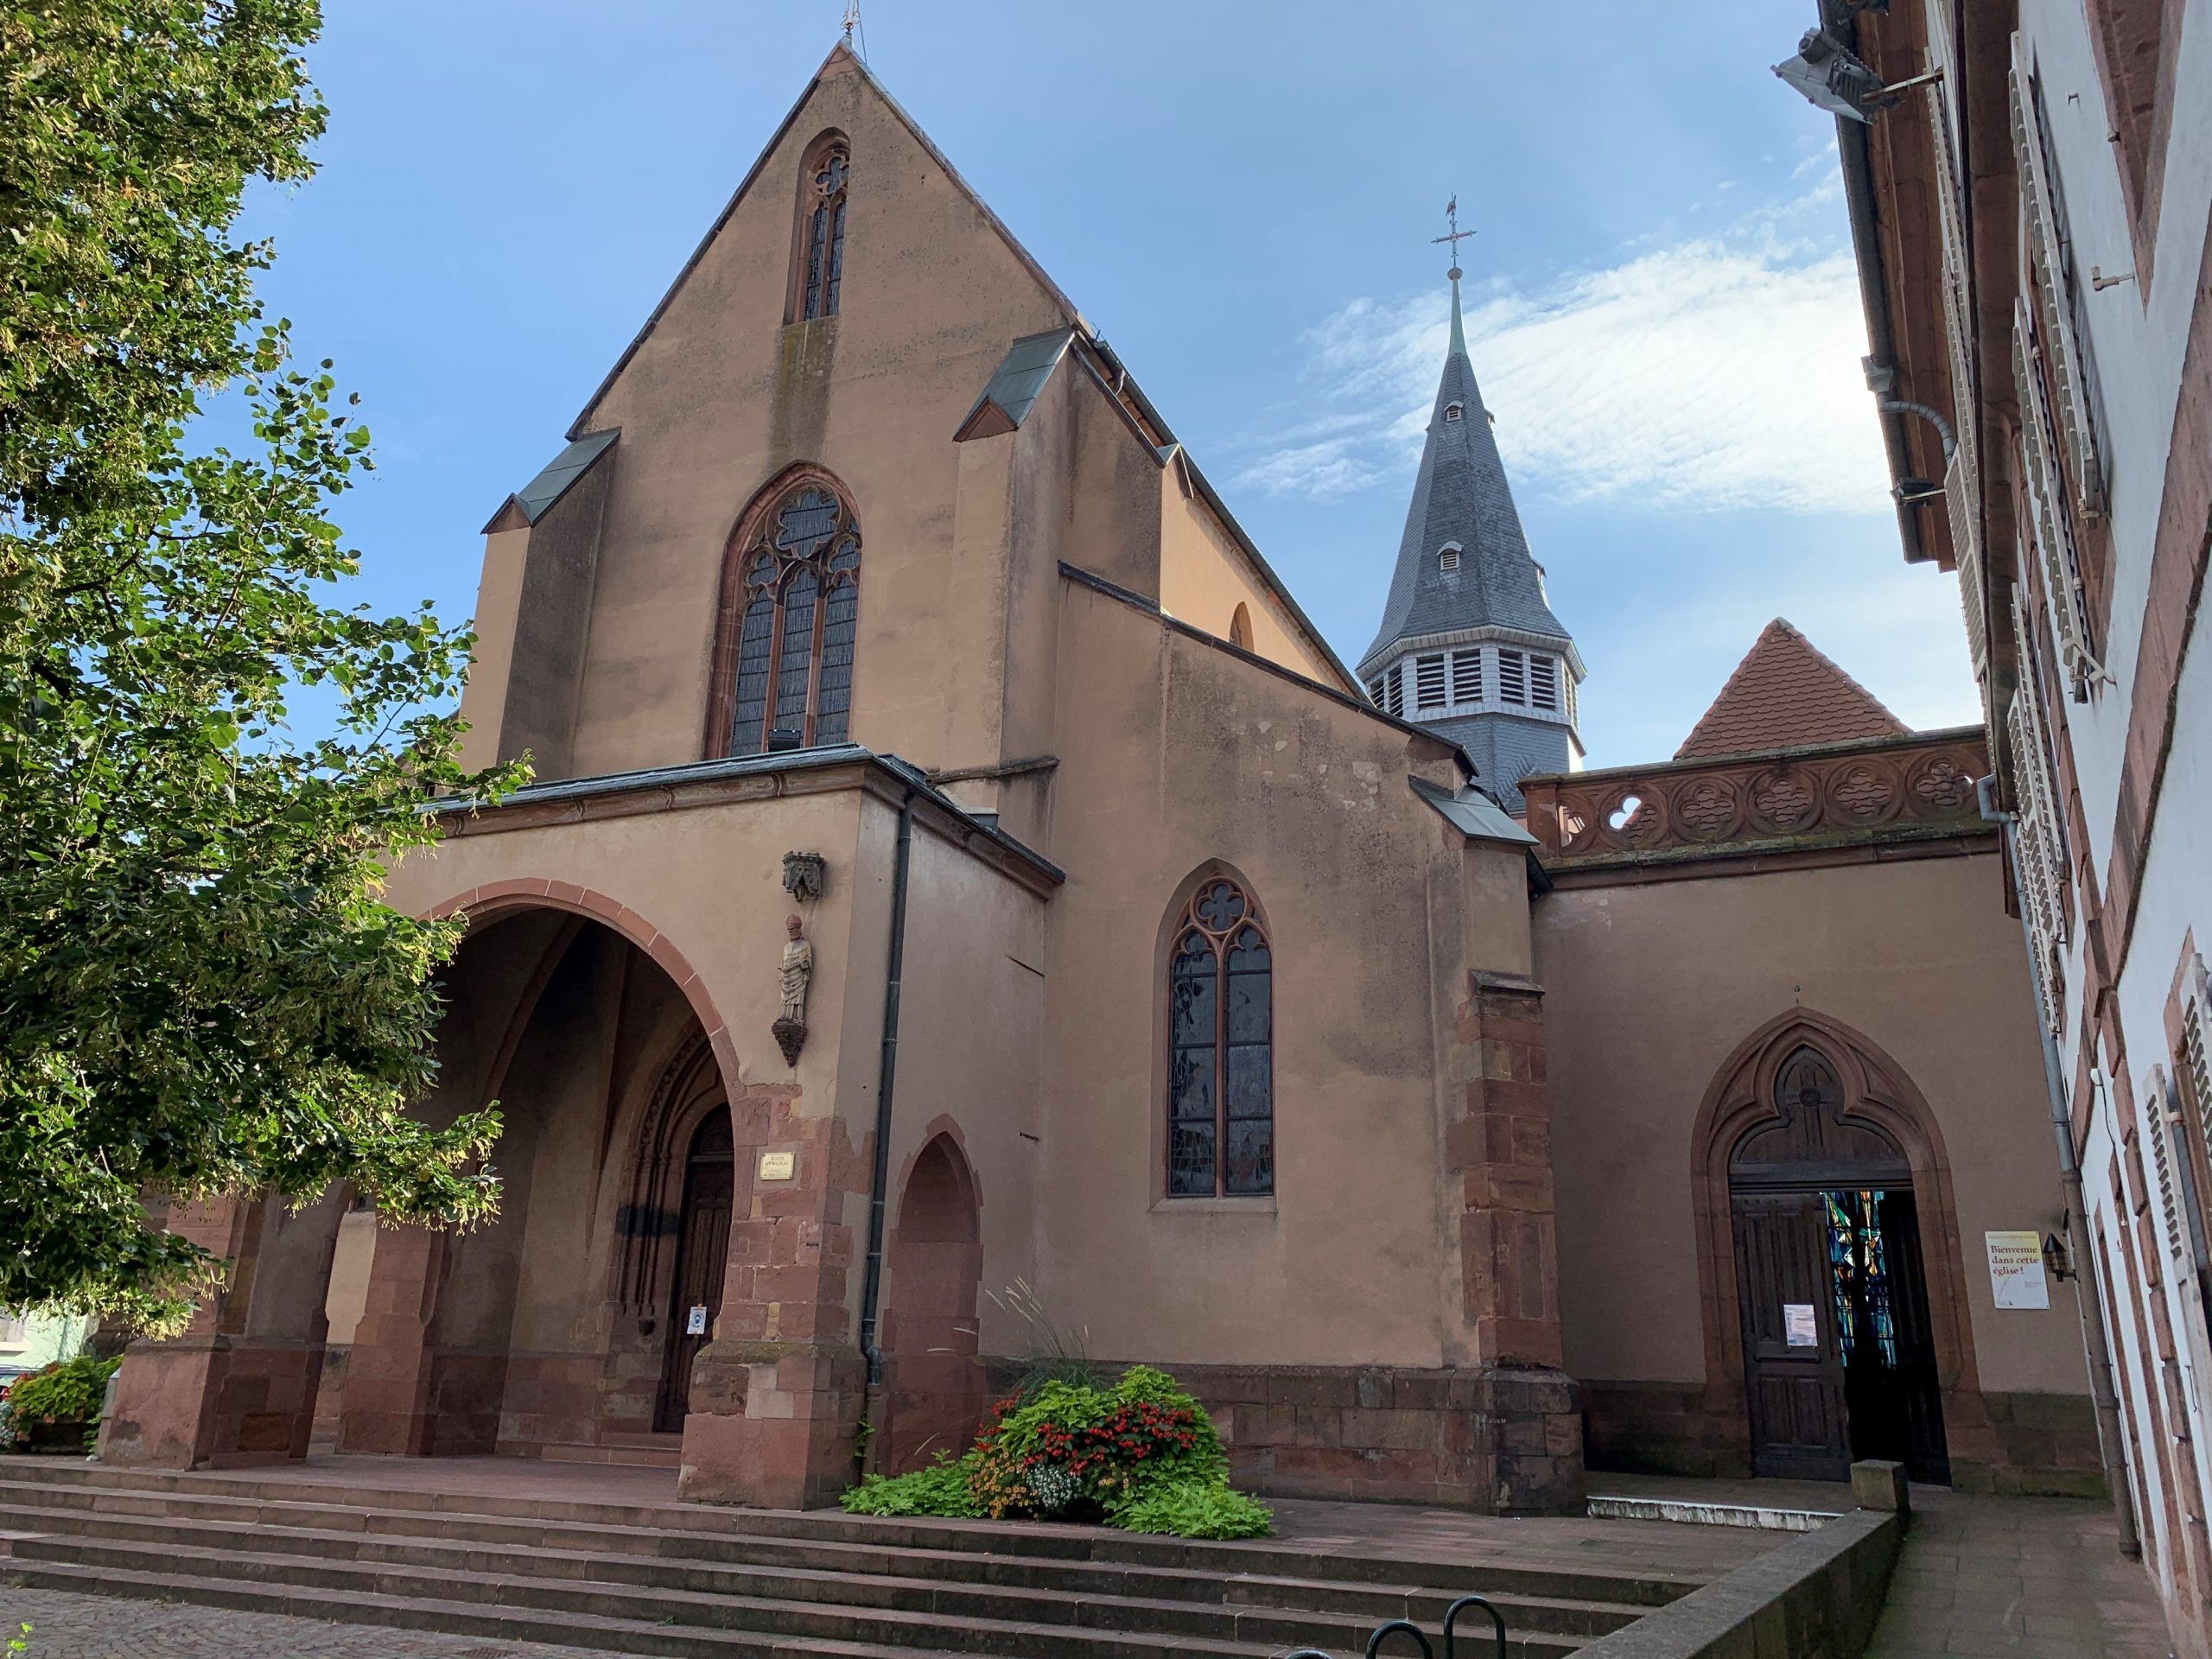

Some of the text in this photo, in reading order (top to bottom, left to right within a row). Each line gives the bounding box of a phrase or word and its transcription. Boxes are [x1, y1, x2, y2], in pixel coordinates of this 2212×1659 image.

[1990, 1245, 2037, 1254] Bienvenue
[1992, 1255, 2014, 1264] dans
[1993, 1267, 2018, 1277] église
